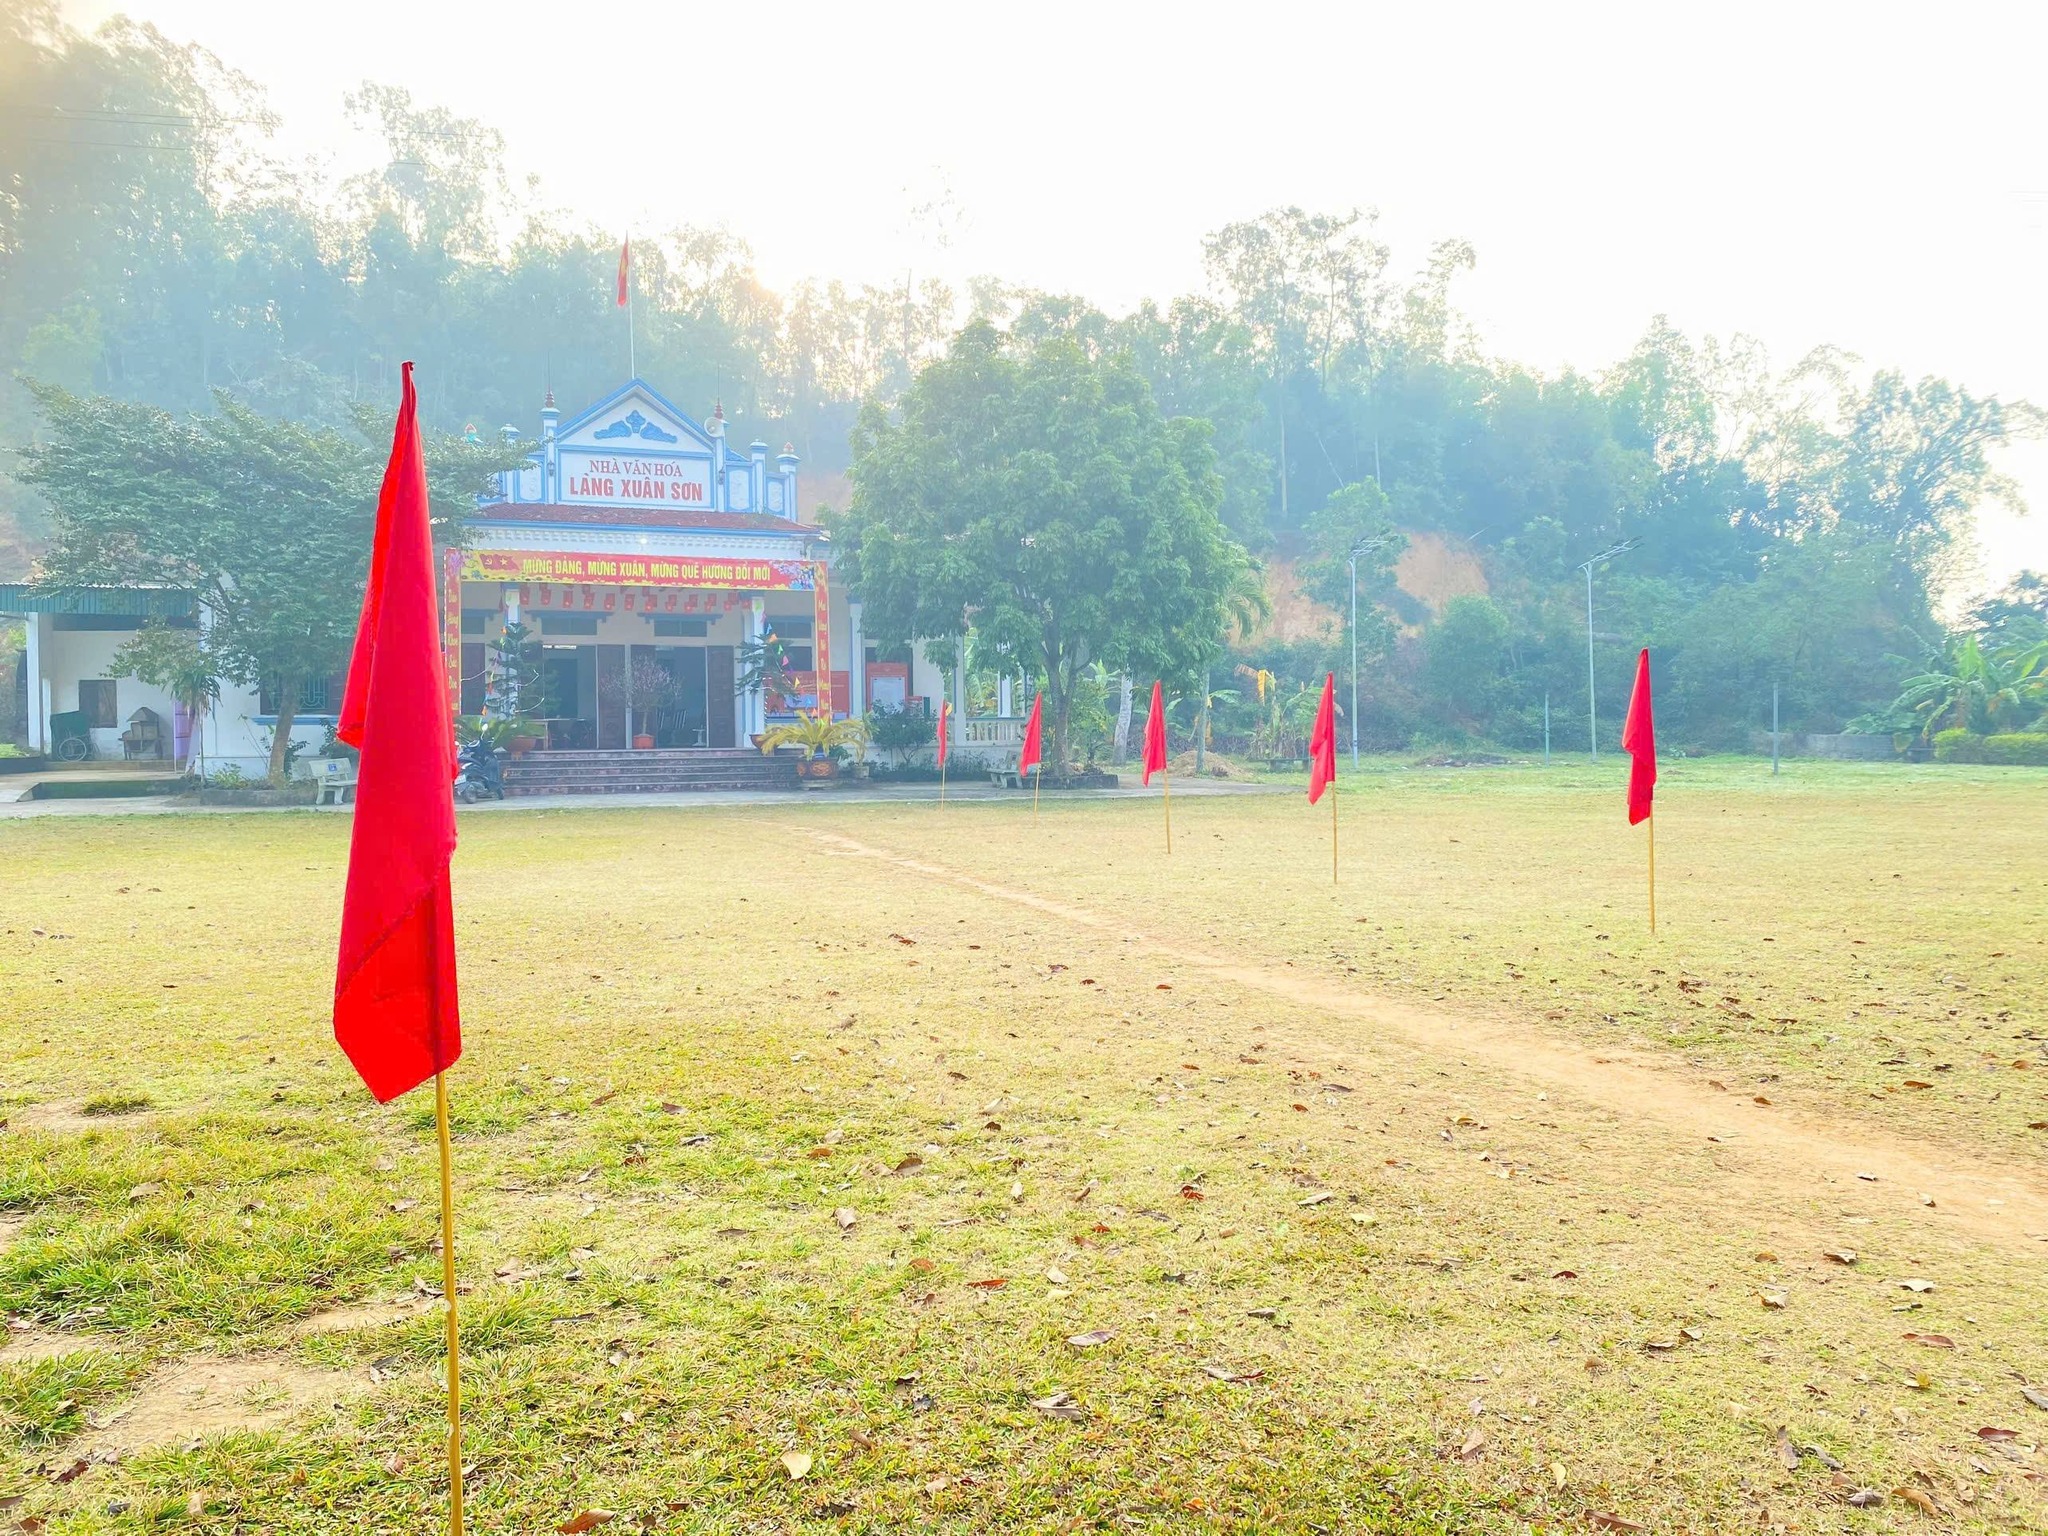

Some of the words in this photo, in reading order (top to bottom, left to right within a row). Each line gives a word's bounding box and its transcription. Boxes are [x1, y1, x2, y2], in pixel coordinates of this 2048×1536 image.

[590, 458, 621, 474] NHÀ
[623, 459, 652, 475] VĂN
[570, 473, 614, 497] LÀNG
[621, 476, 665, 499] XUÂN
[671, 481, 702, 501] SƠN
